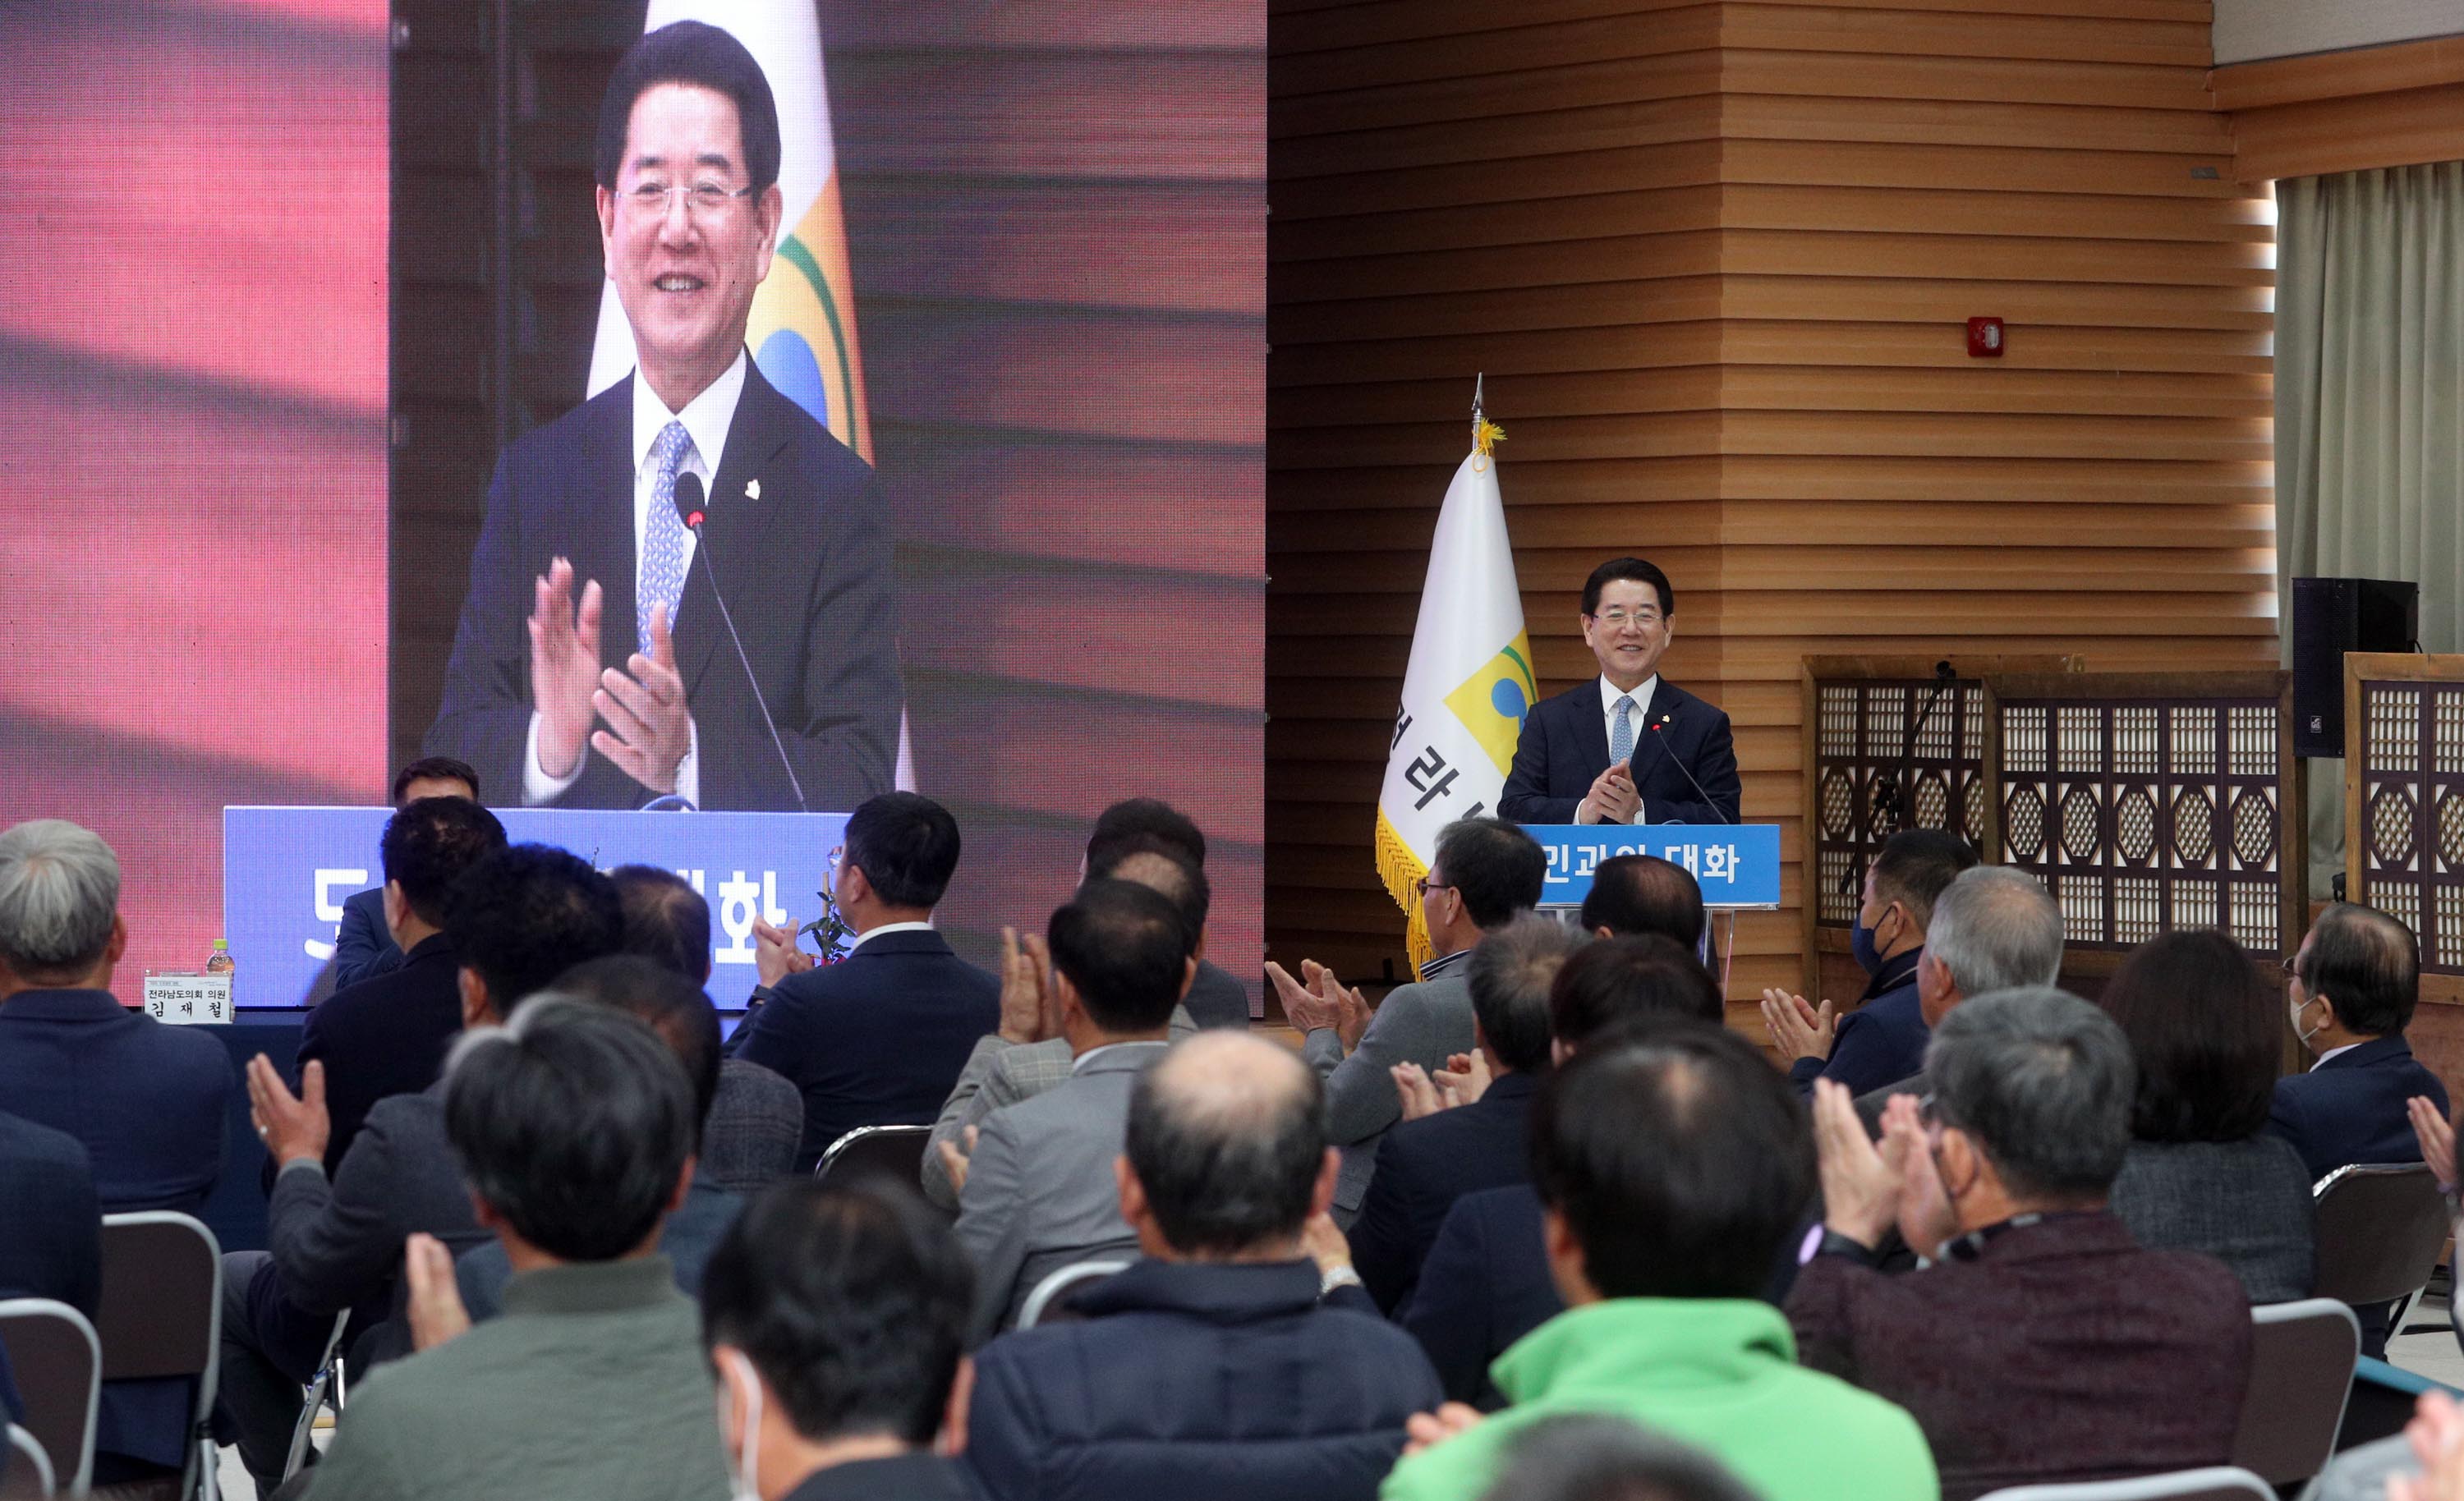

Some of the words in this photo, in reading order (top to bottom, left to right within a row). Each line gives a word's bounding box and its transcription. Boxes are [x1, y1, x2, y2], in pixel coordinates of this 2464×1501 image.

[1664, 844, 1740, 884] 대화
[149, 989, 203, 999] 전라남도의회
[208, 989, 226, 999] 의원
[151, 1001, 164, 1017] 김
[180, 1001, 193, 1017] 재
[208, 1001, 222, 1018] 철
